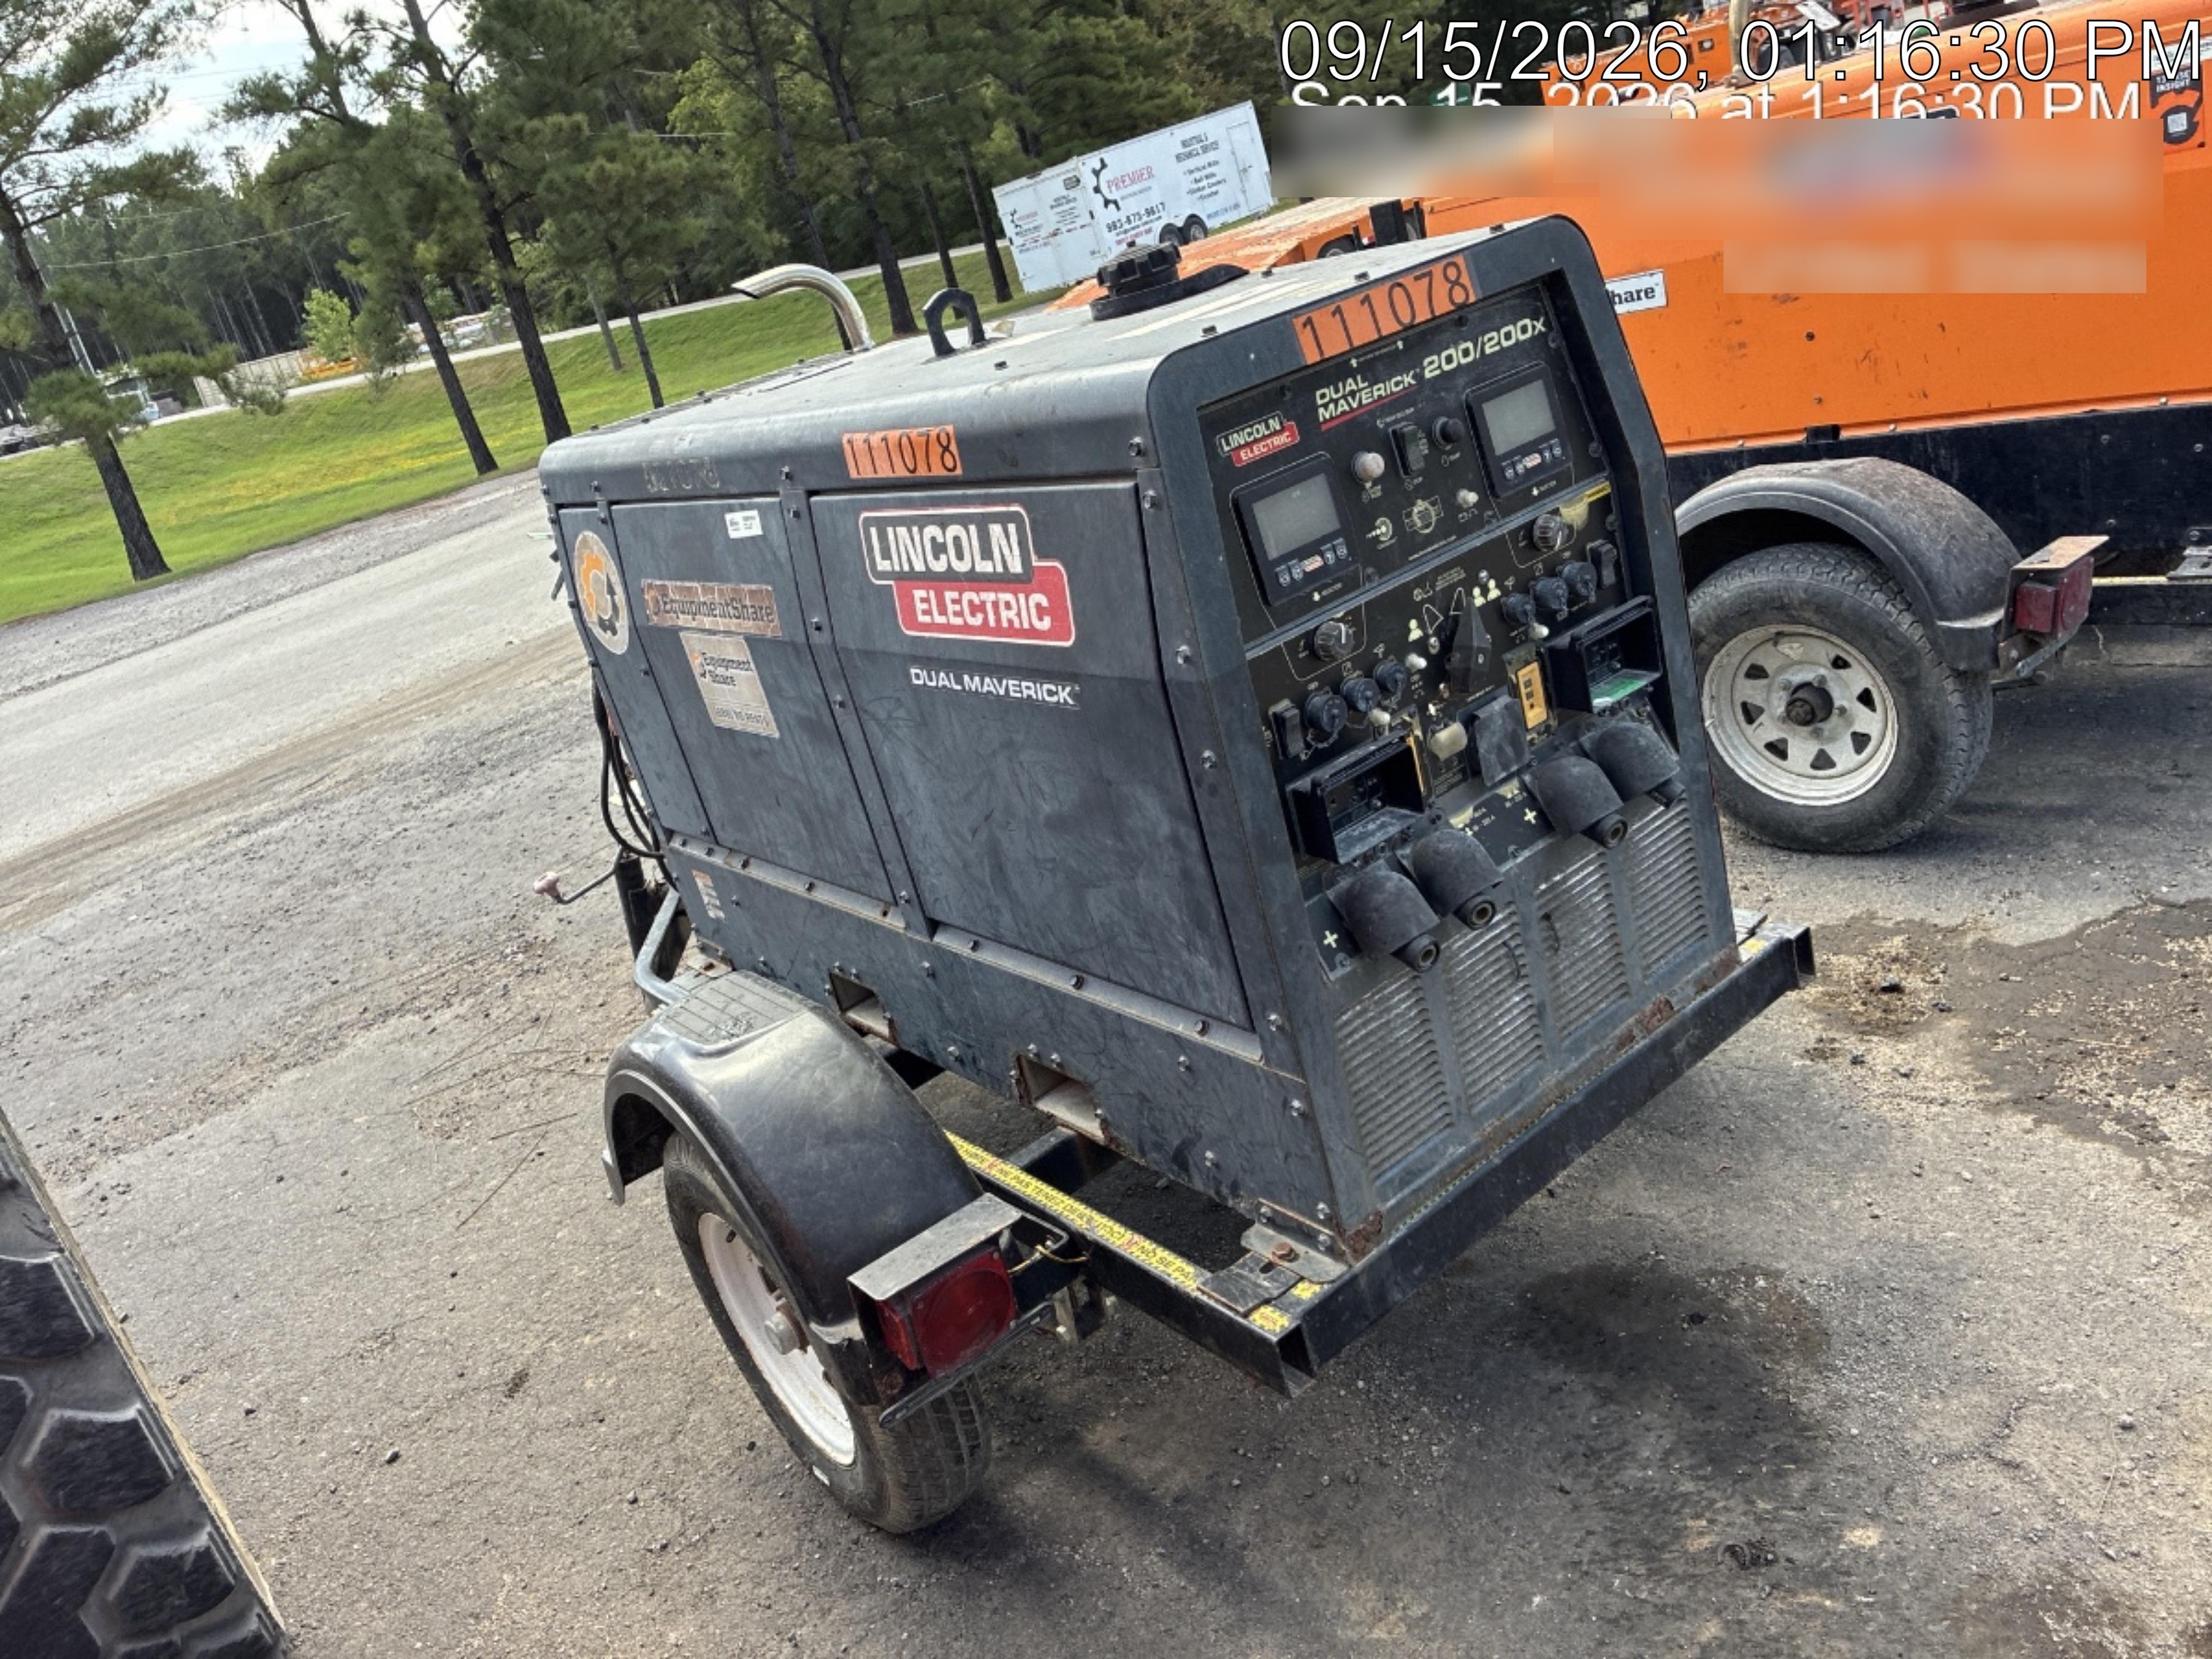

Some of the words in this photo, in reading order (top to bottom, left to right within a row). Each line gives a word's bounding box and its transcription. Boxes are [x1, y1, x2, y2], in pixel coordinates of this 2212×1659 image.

[1106, 166, 1154, 194] PREMIER
[1301, 261, 1470, 360] 111078
[1609, 286, 1656, 305] hare
[1315, 374, 1369, 405] DUAL
[1317, 369, 1417, 423] MAVERICK
[847, 426, 957, 476] 111078
[1221, 416, 1282, 452] LINCOLN
[1240, 431, 1291, 461] ELECTRIC
[869, 523, 1023, 574] LINCOLN
[662, 594, 775, 622] EquipmentShare
[912, 588, 1052, 631] ELECTRIC
[704, 653, 753, 672] Equipment
[910, 668, 963, 690] DUAL
[962, 673, 1076, 705] MAVERICK
